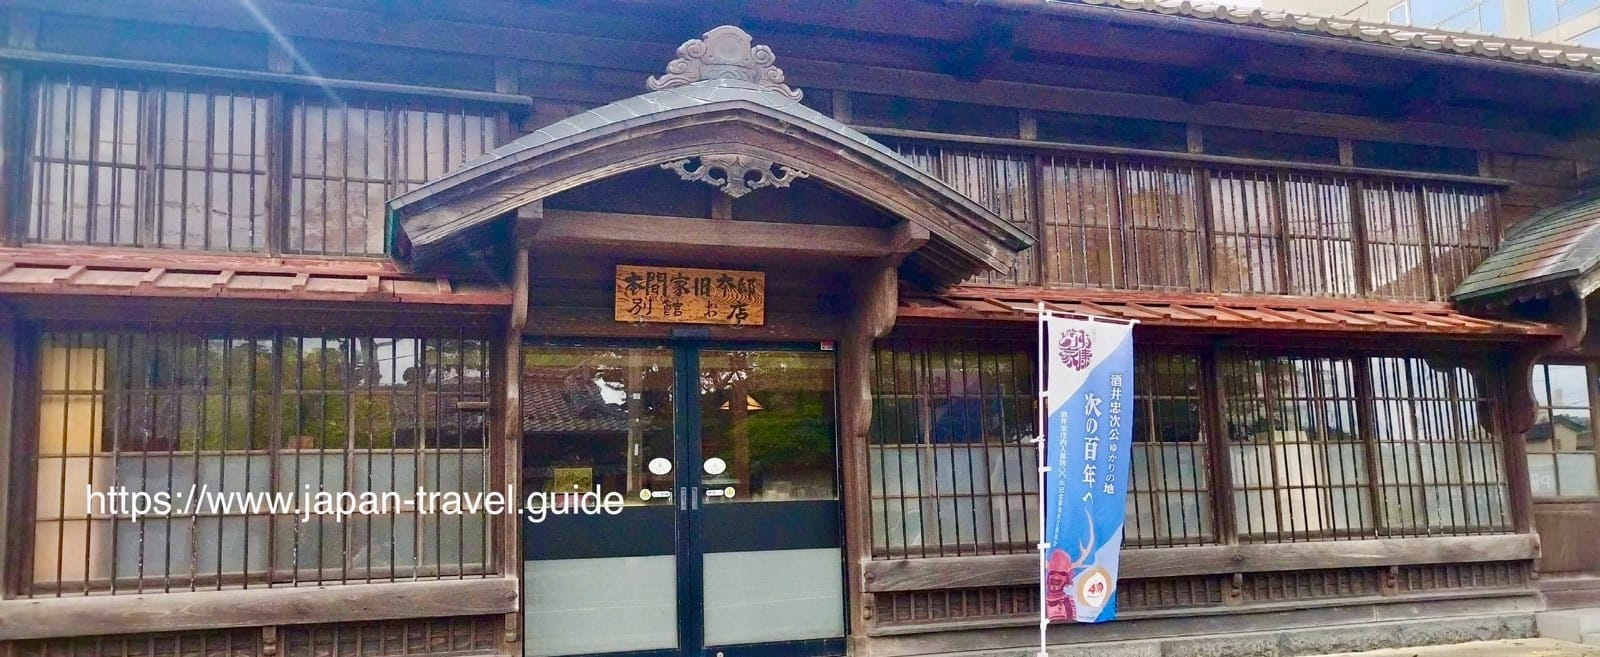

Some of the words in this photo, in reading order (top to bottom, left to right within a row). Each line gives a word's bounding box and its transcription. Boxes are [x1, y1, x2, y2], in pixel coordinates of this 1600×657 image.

[628, 298, 683, 317] 別館
[704, 300, 750, 322] お店
[1082, 392, 1102, 505] 次の百年へ
